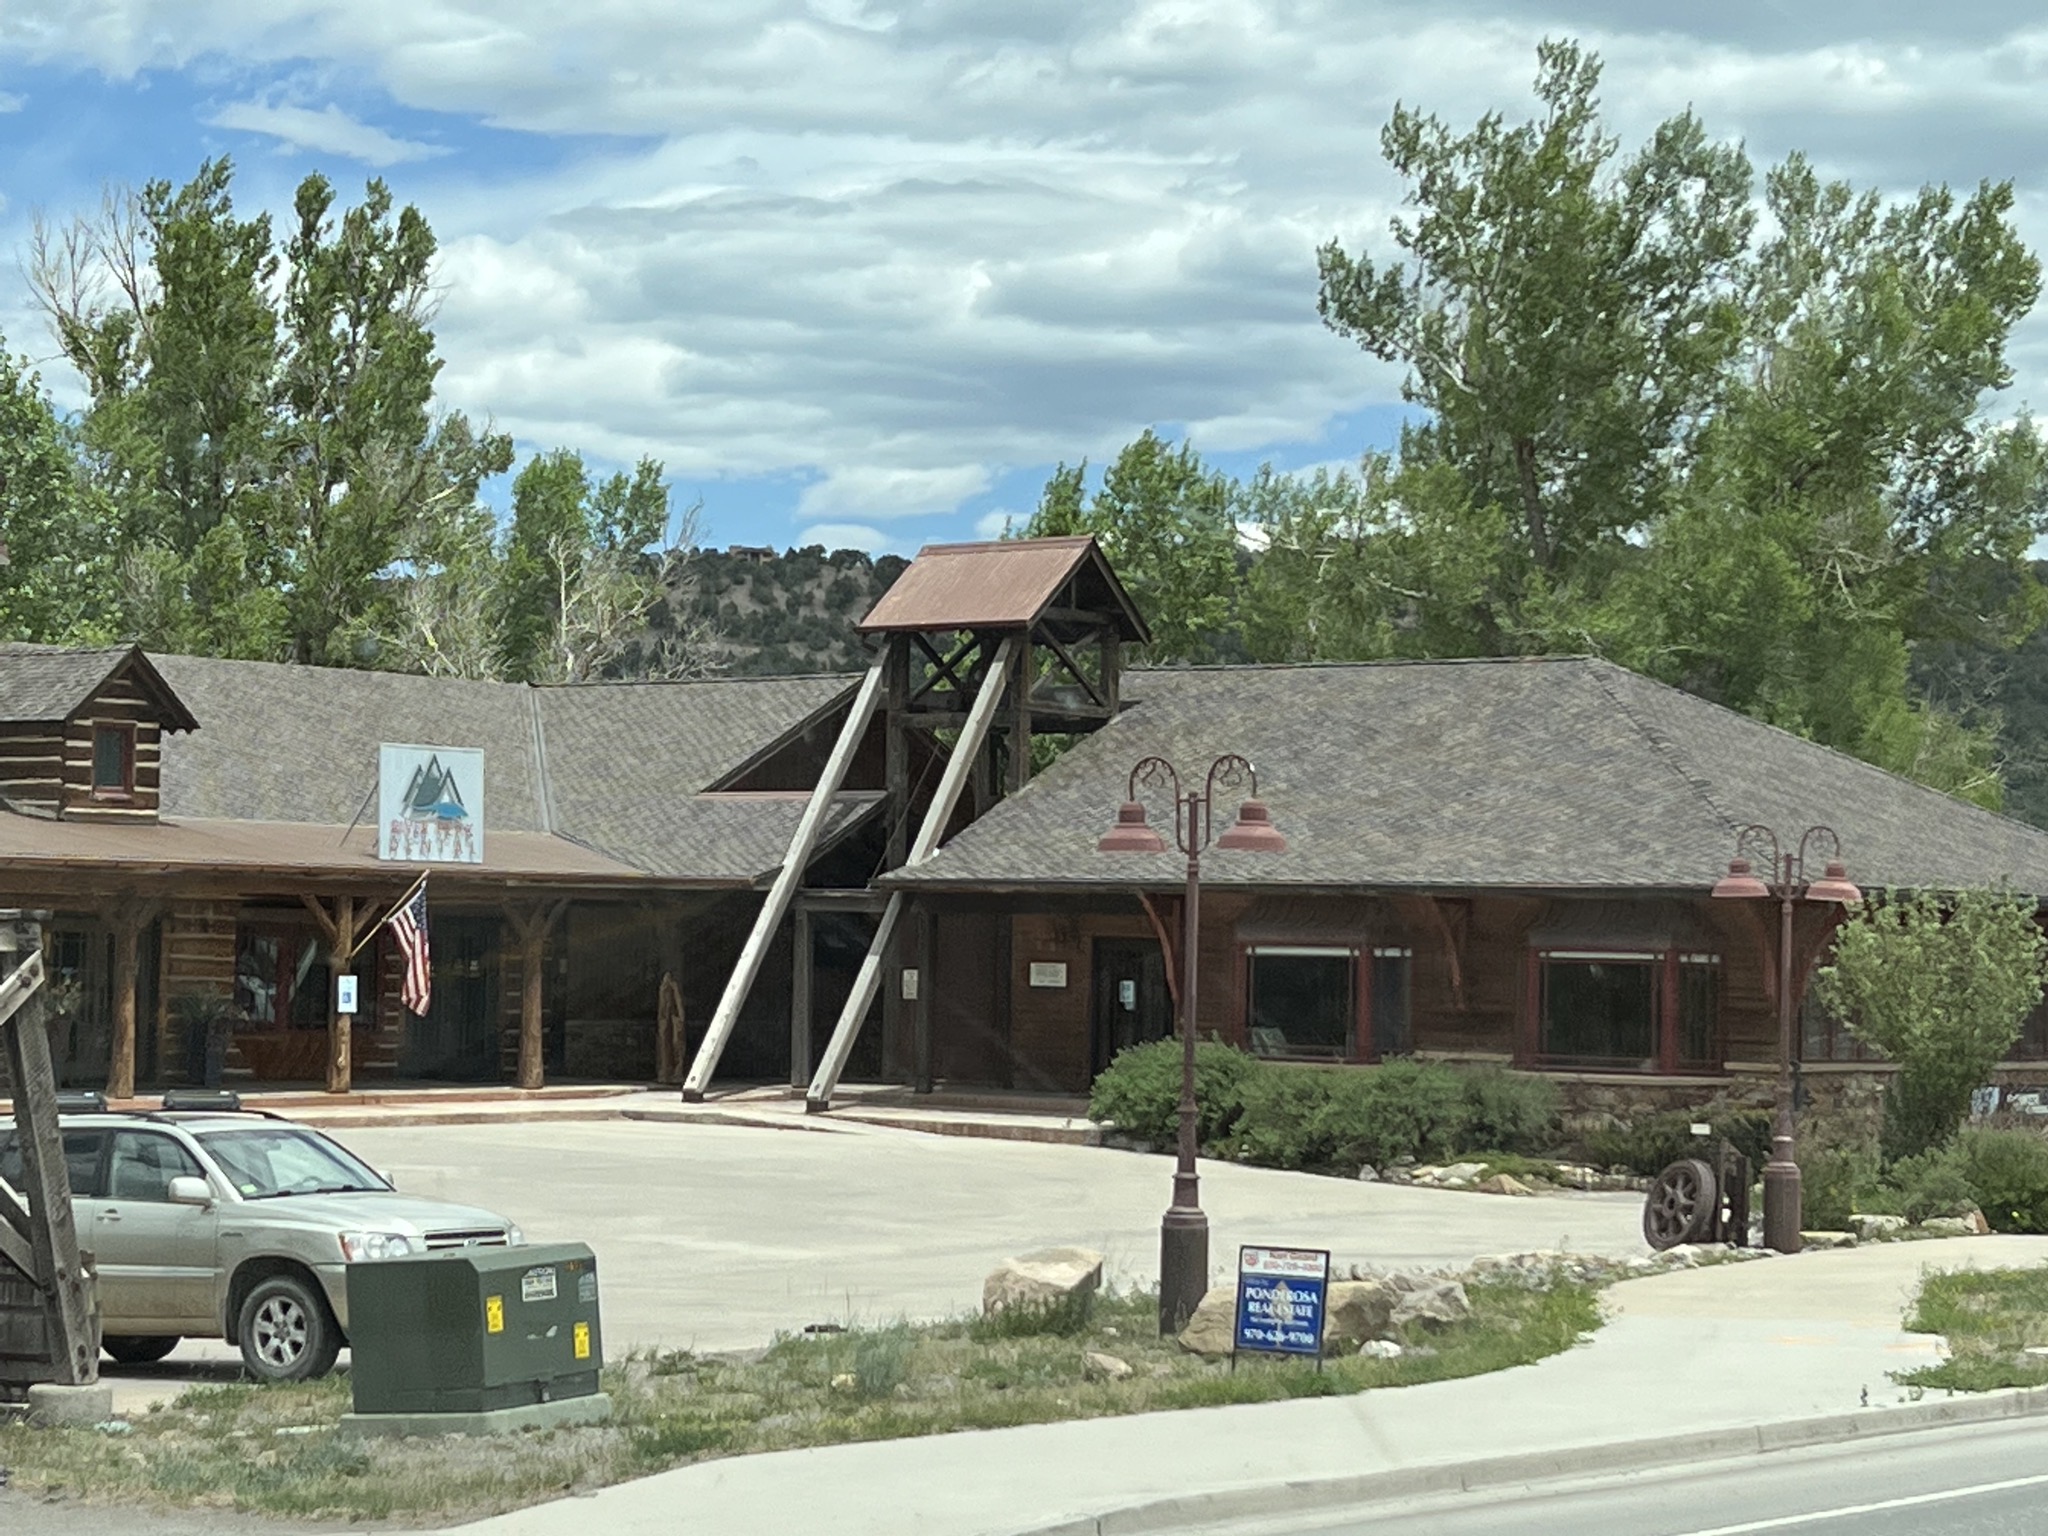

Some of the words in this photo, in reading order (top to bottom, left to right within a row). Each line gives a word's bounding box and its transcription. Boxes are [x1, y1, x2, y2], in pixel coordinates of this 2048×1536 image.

[1245, 1287, 1318, 1304] PONDEROSA
[1247, 1301, 1275, 1316] REAL
[1276, 1304, 1314, 1318] ESTATE
